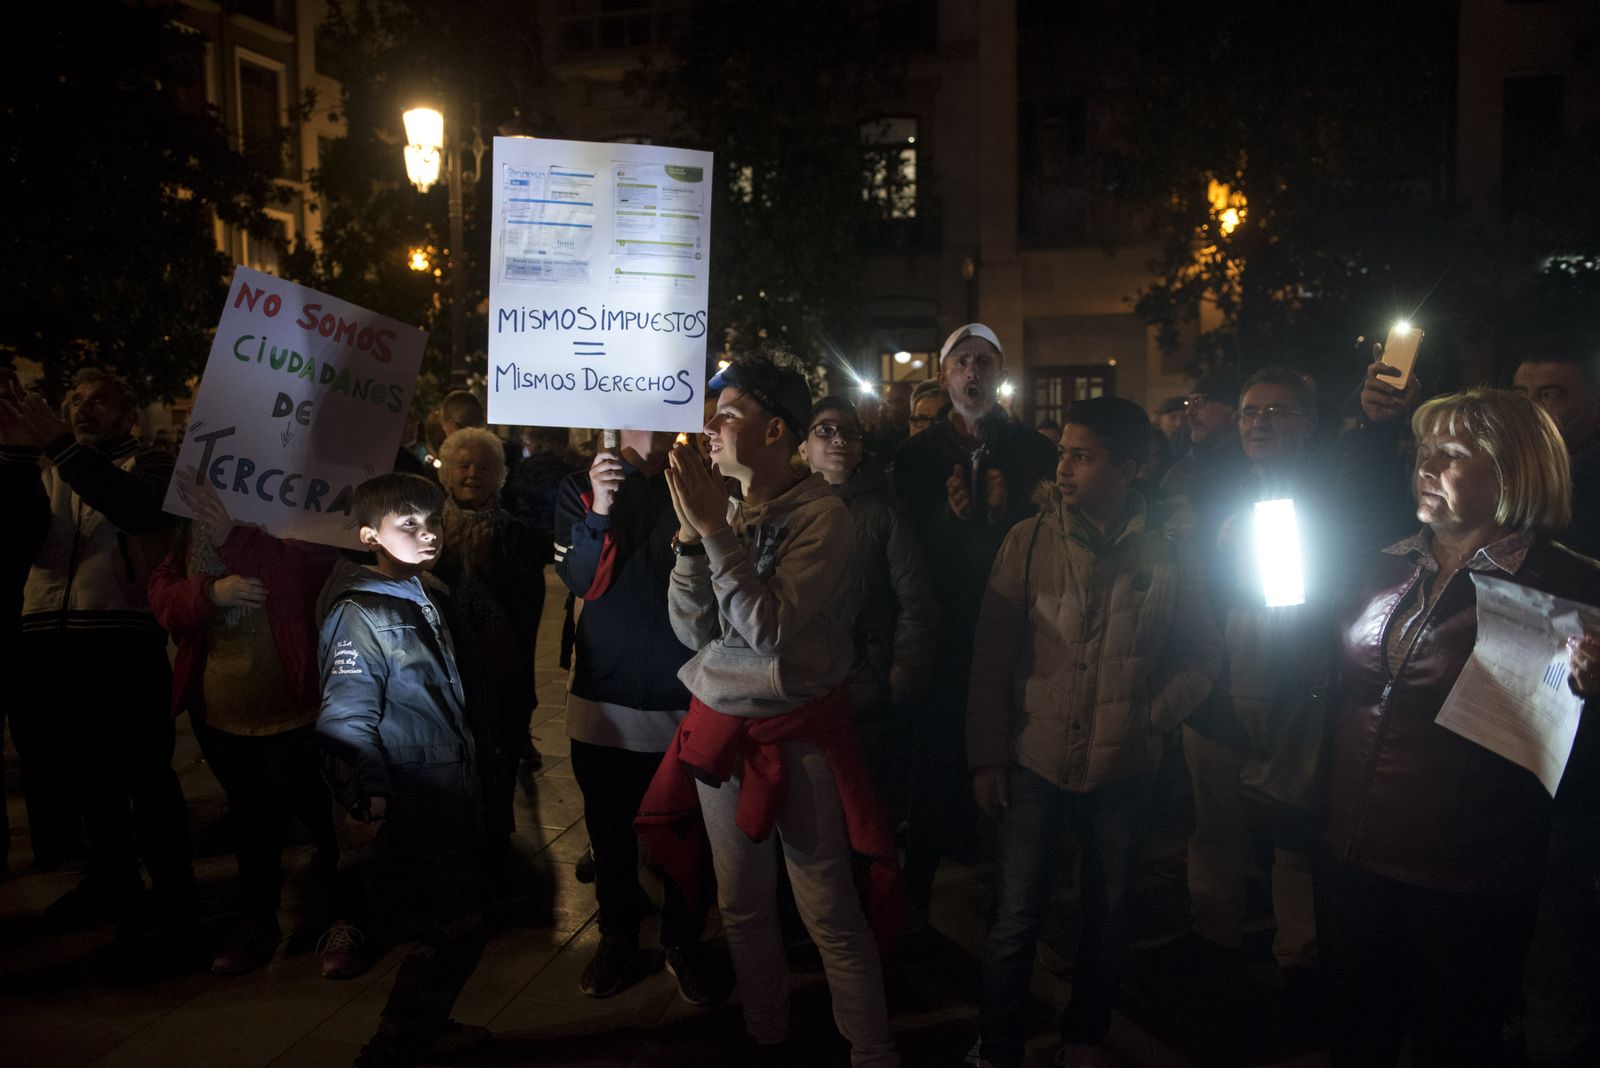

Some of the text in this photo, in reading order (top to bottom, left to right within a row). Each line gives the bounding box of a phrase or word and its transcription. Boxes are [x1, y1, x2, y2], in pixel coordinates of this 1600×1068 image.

[233, 281, 397, 364] NO SOMOS
[272, 391, 315, 426] DE
[581, 367, 694, 405] DERECHOS
[194, 426, 354, 516] TERCERA
